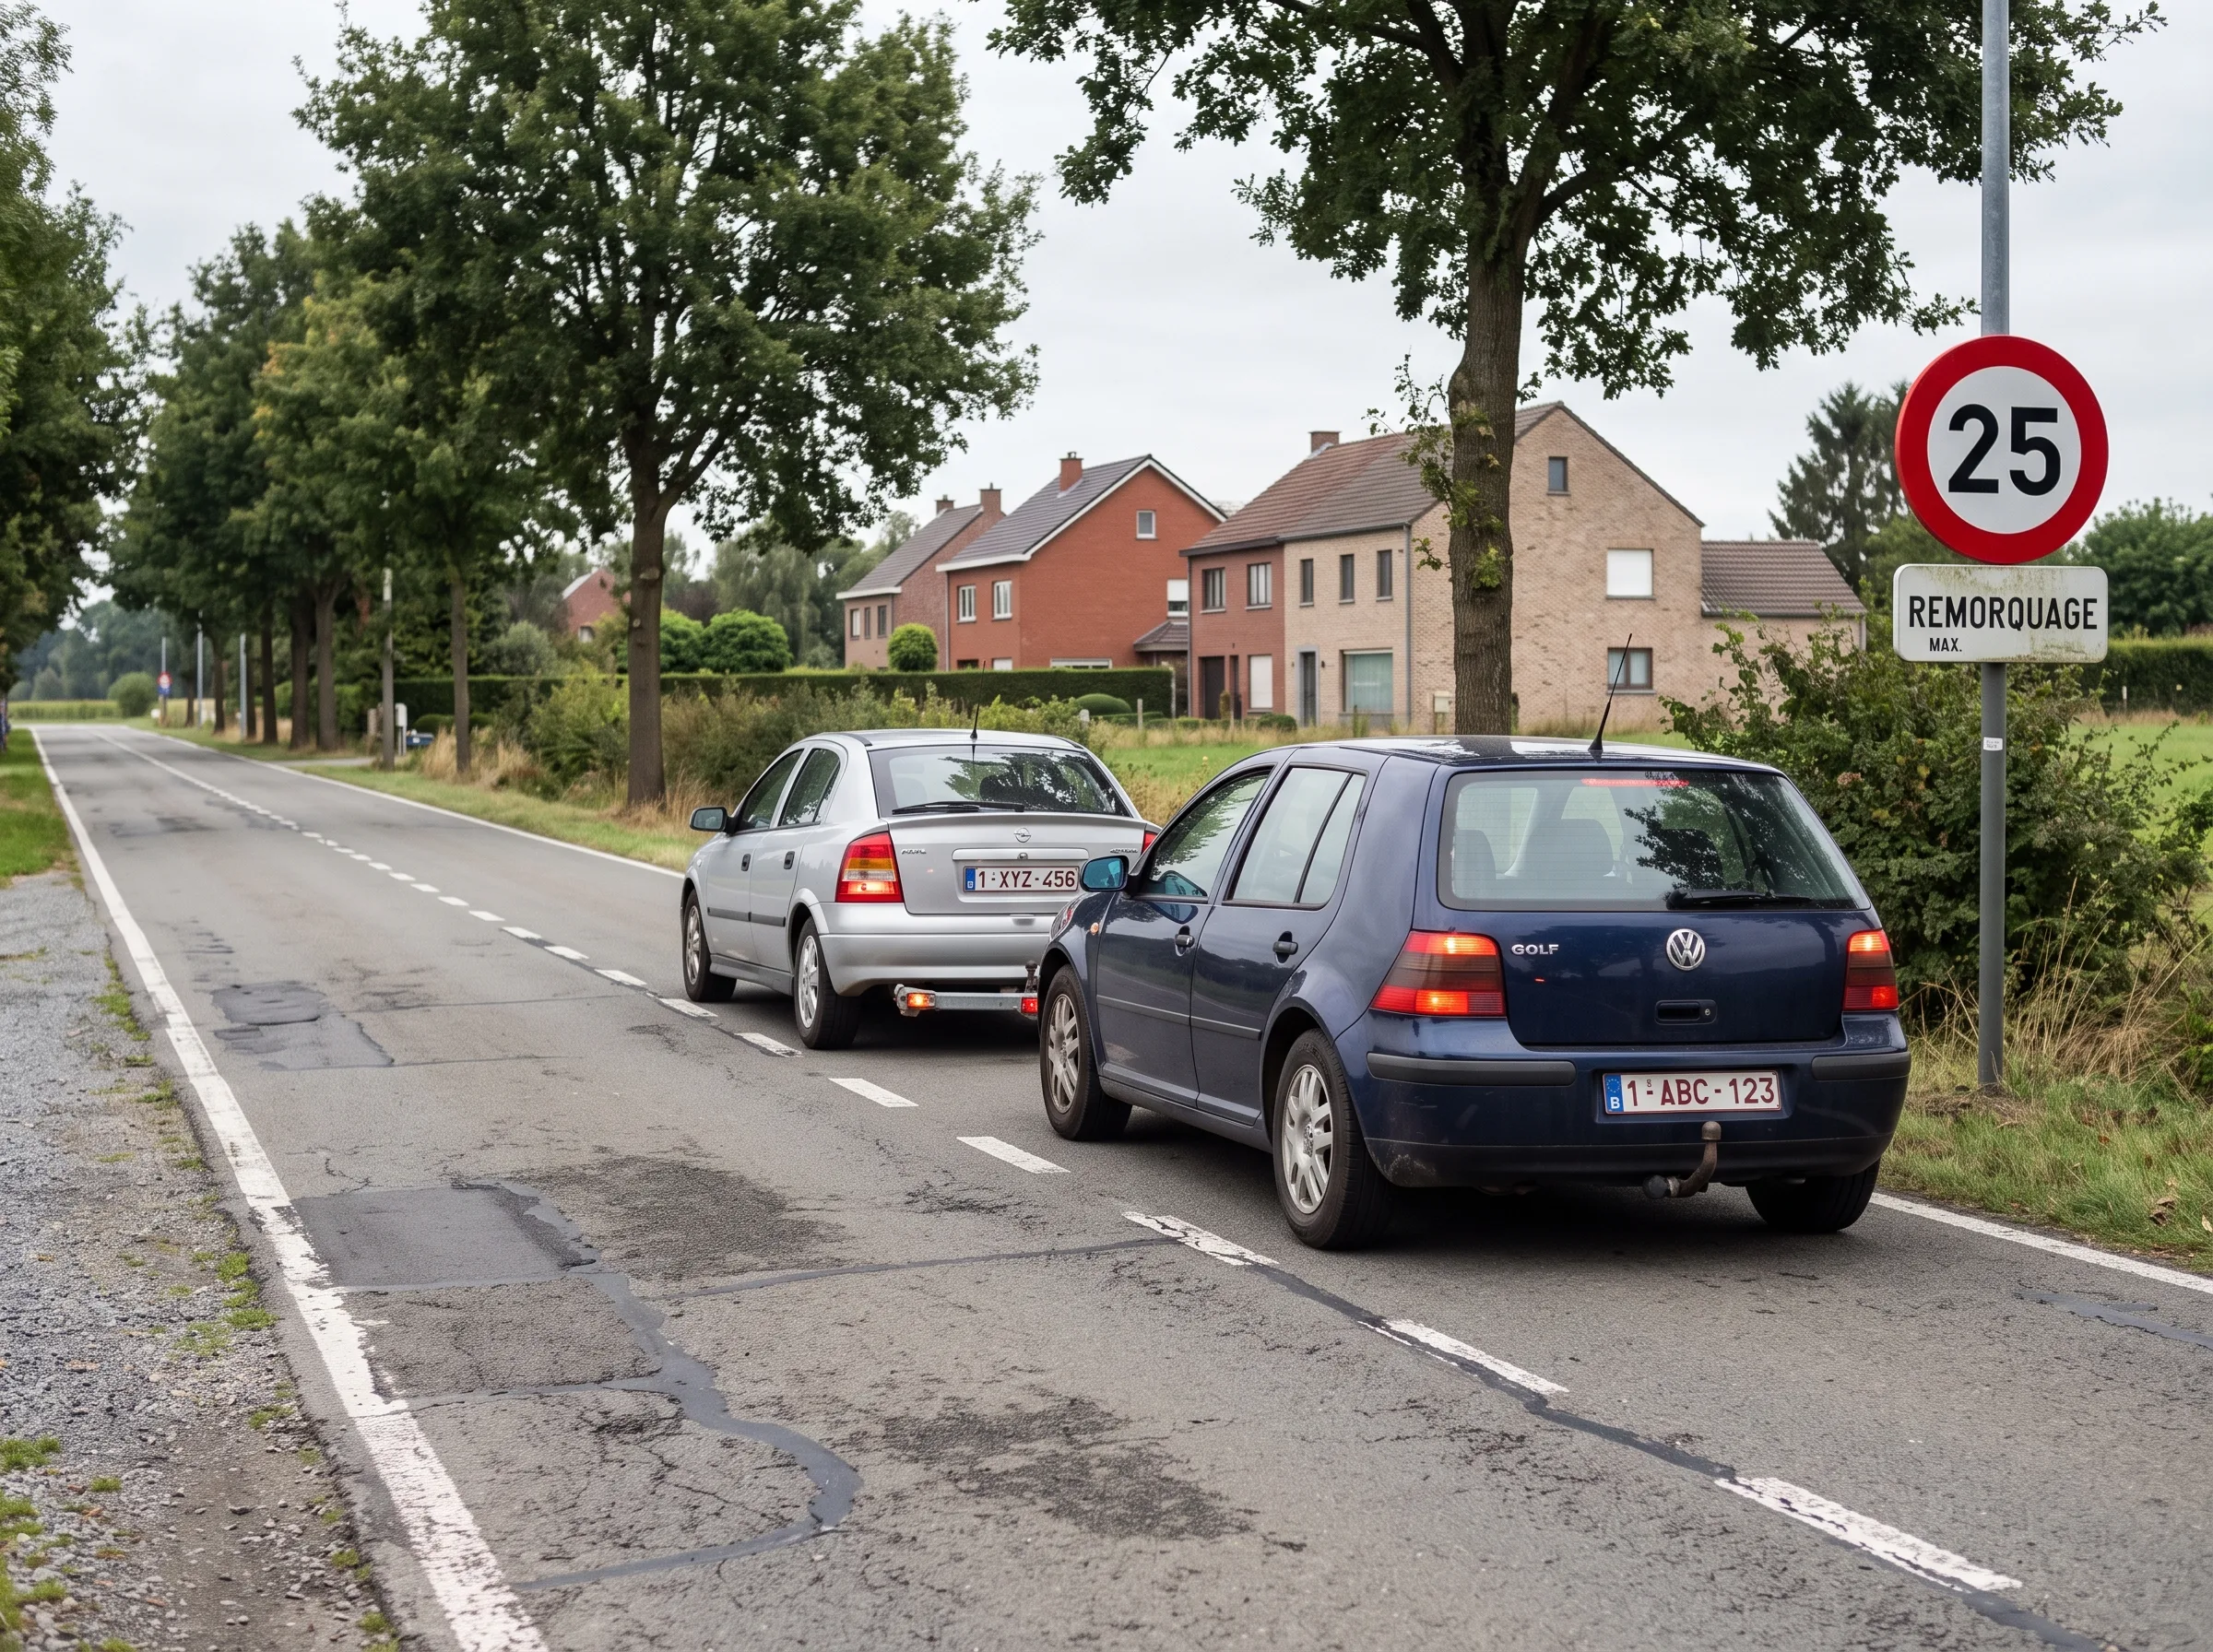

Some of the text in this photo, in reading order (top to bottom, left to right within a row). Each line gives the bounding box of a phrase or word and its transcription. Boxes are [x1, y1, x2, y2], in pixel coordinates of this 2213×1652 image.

[1948, 403, 2061, 496] 25
[1909, 596, 2098, 631] REMORQUAGE
[1929, 637, 1963, 652] MAX.
[978, 870, 1076, 889] 1-XYZ-456
[1510, 943, 1559, 955] GOLF
[1610, 1096, 1621, 1109] B
[1627, 1077, 1775, 1107] 1-ABC-123
